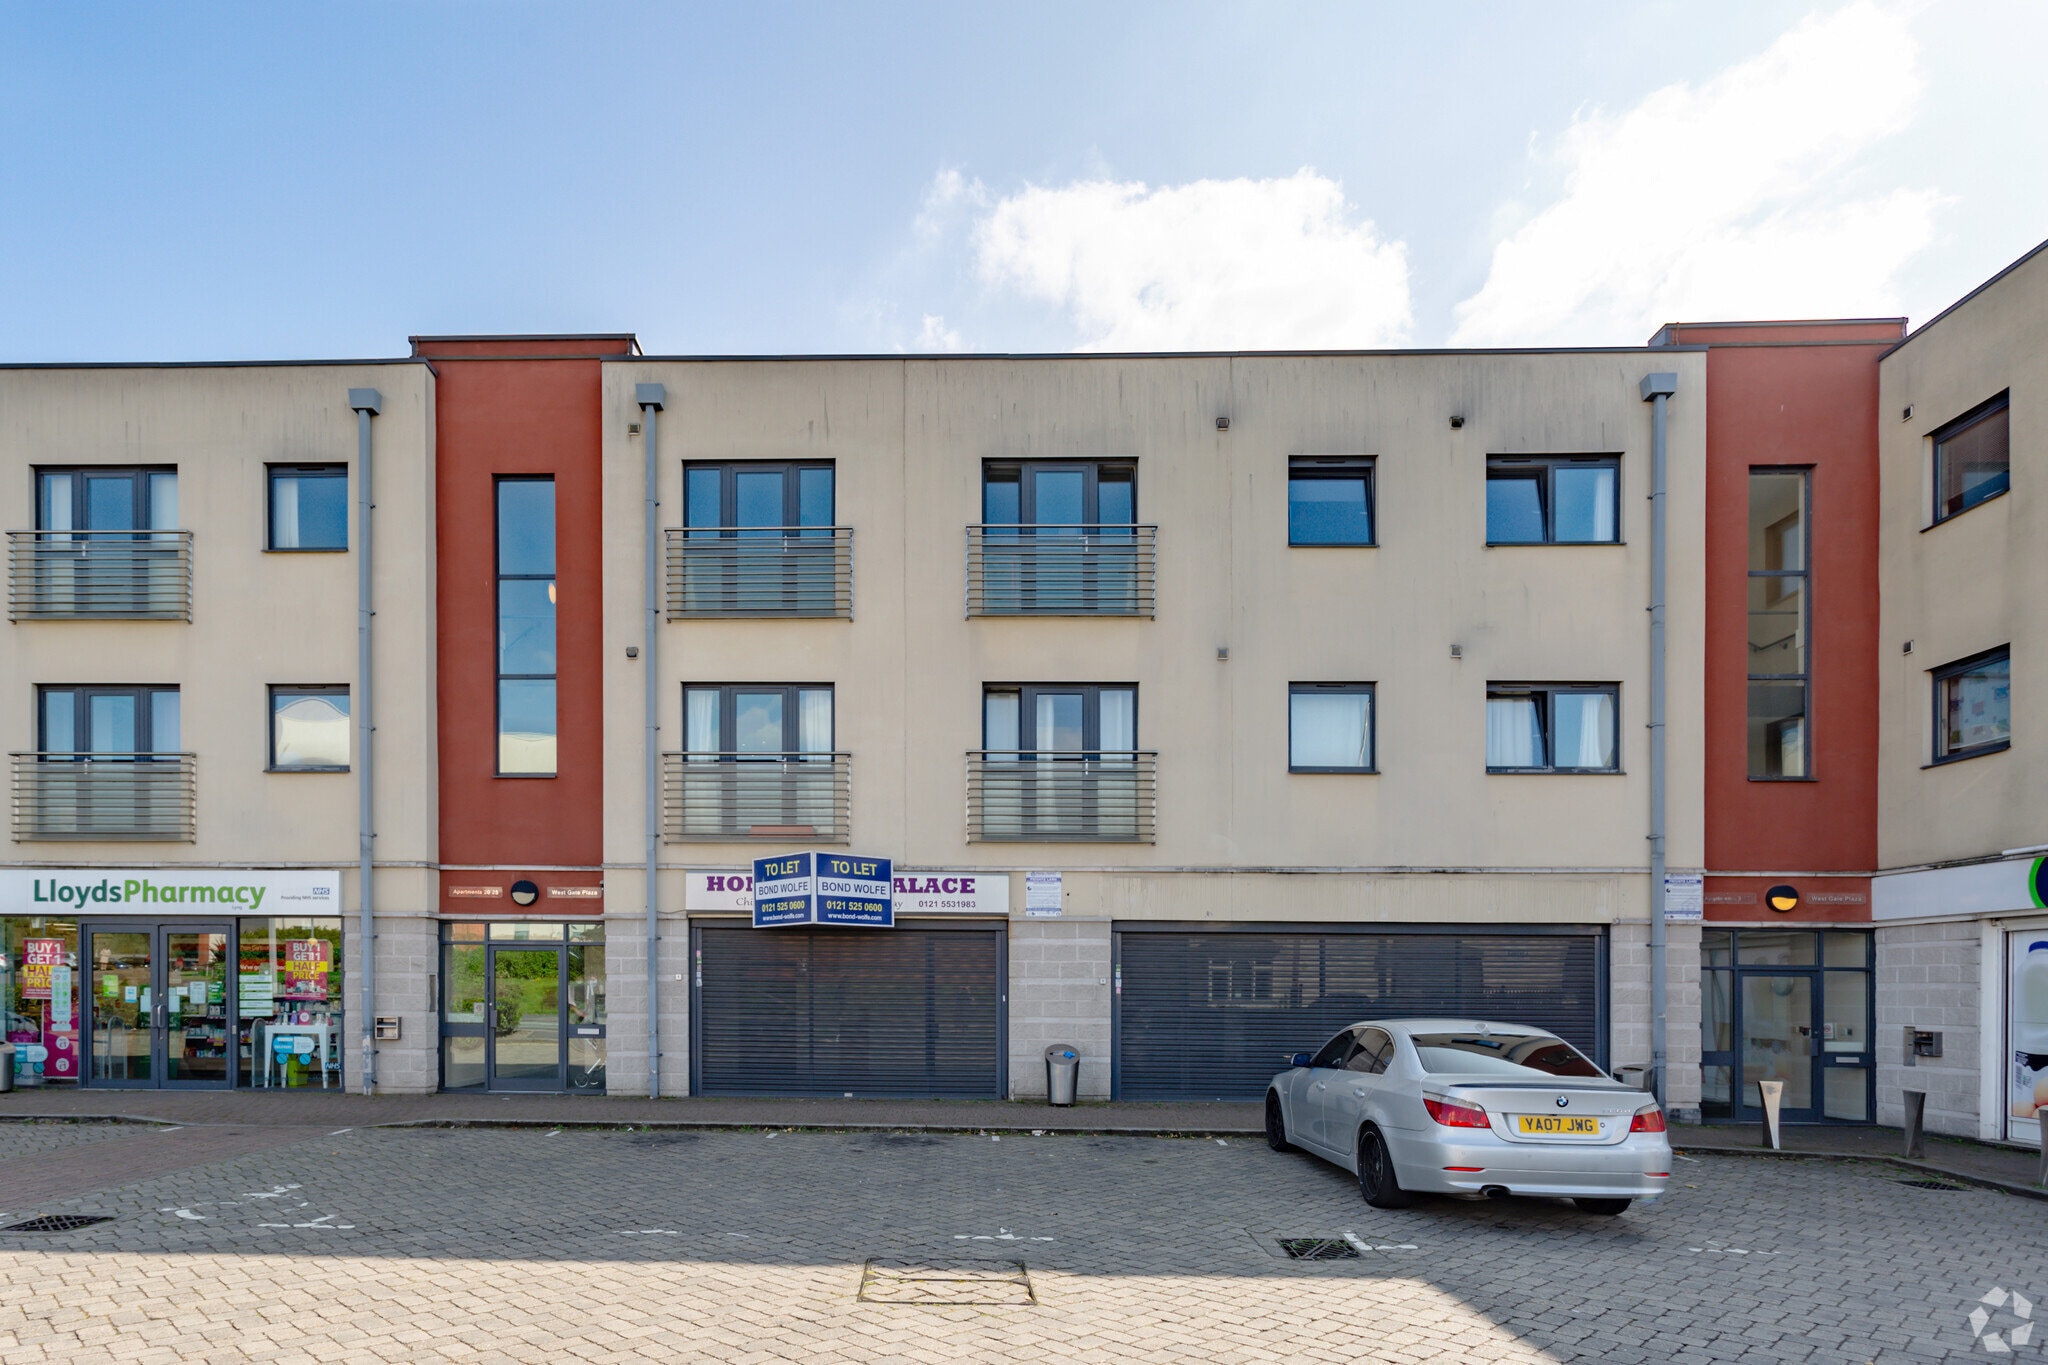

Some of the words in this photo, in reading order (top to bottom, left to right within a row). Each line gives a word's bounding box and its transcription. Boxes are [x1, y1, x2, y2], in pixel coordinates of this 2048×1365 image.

[765, 863, 778, 876] TO
[780, 860, 800, 875] LET
[831, 860, 850, 875] TO
[853, 863, 877, 877] LET
[313, 887, 330, 895] NHS
[759, 884, 779, 896] BOND
[780, 881, 808, 893] WOLFE
[822, 882, 852, 893] BOND
[854, 884, 886, 895] WOLFE
[893, 877, 976, 894] ALACE
[33, 879, 267, 910] LloydsPharmacy
[735, 897, 753, 906] Chi
[918, 900, 938, 908] 0121
[941, 900, 976, 908] 5531983
[761, 904, 775, 913] 0121
[776, 902, 788, 912] 525
[789, 900, 805, 910] 0600
[827, 901, 846, 910] 0121
[848, 902, 863, 911] 525
[864, 902, 883, 912] 0600
[762, 913, 805, 921] www.bond-wolfe.com
[828, 913, 882, 921] www.bond-wolfe.com
[27, 942, 53, 954] BUY
[54, 943, 61, 954] 1
[292, 942, 313, 952] BUY
[315, 943, 321, 951] 1
[27, 953, 53, 965] GET
[54, 954, 61, 965] 1
[293, 952, 312, 961] GET
[27, 965, 52, 978] HAL
[293, 962, 321, 971] HALF
[292, 971, 320, 980] PRICE
[26, 978, 52, 988] PRIC
[1525, 1117, 1562, 1131] YA07
[1567, 1119, 1594, 1132] JWG
